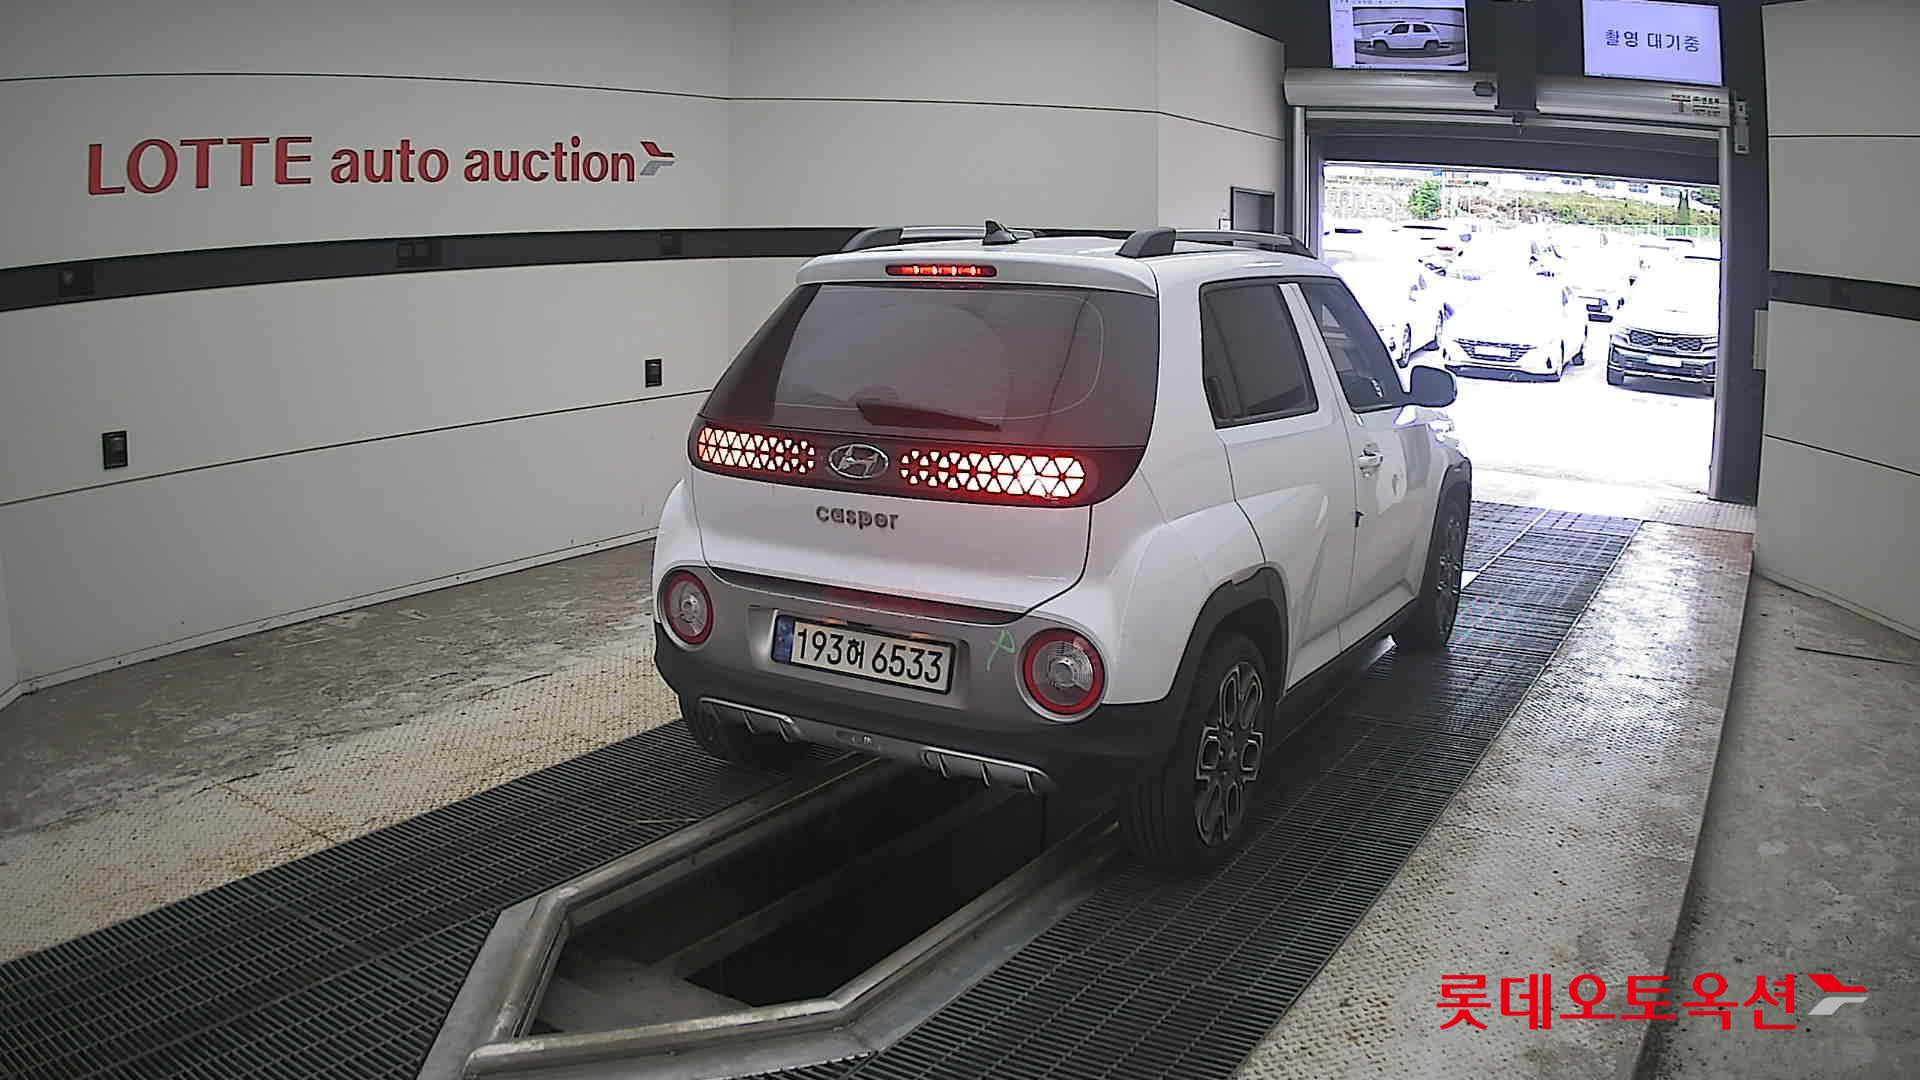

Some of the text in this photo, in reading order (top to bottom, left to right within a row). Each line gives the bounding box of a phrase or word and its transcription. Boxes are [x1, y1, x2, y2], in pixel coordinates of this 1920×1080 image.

[1606, 29, 1700, 53] 촬영 대기중
[87, 136, 637, 195] LOTTE auto auction
[816, 505, 899, 530] casper
[797, 628, 942, 683] 193허 6533
